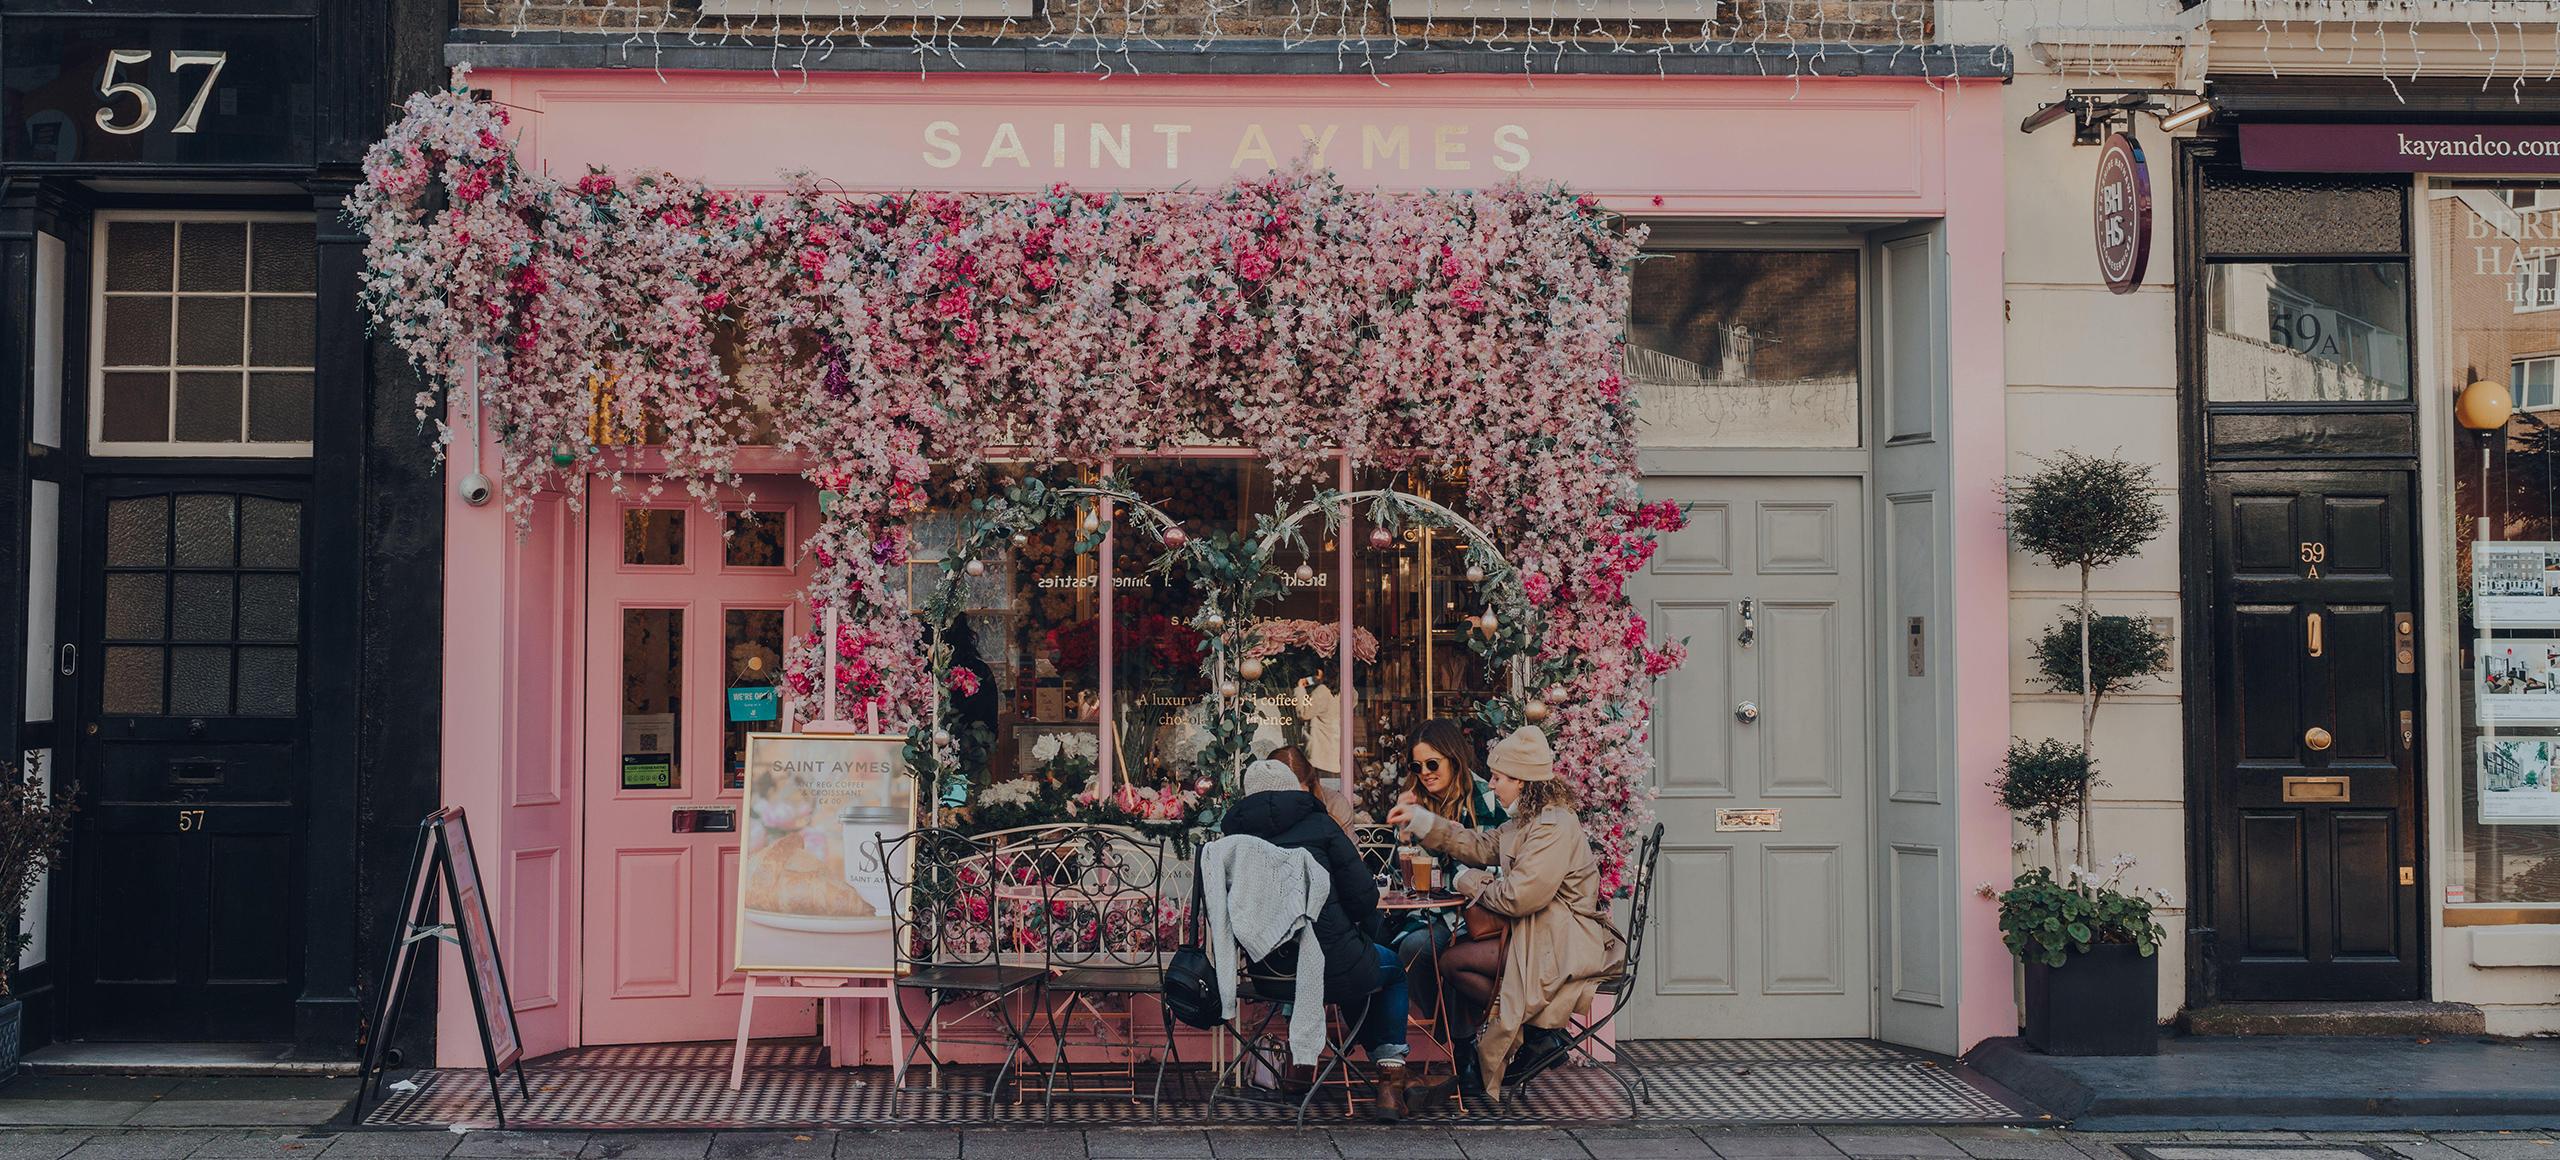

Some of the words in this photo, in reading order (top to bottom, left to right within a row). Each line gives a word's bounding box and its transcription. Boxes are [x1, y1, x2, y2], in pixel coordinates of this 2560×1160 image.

[95, 49, 227, 135] 57
[922, 120, 1192, 169] SAINT
[1230, 123, 1530, 172] AYMES
[2397, 133, 2560, 161] kayandco.com
[2103, 181, 2123, 215] BH
[2105, 215, 2125, 249] HS
[2301, 542, 2325, 563] 59
[2307, 564, 2319, 579] A
[1139, 694, 1149, 706] A
[1152, 693, 1195, 708] luxury
[1261, 692, 1298, 706] coffee
[1302, 693, 1313, 706] &
[773, 760, 825, 772] SAINT
[832, 761, 891, 773] AYMES
[179, 810, 205, 831] 57
